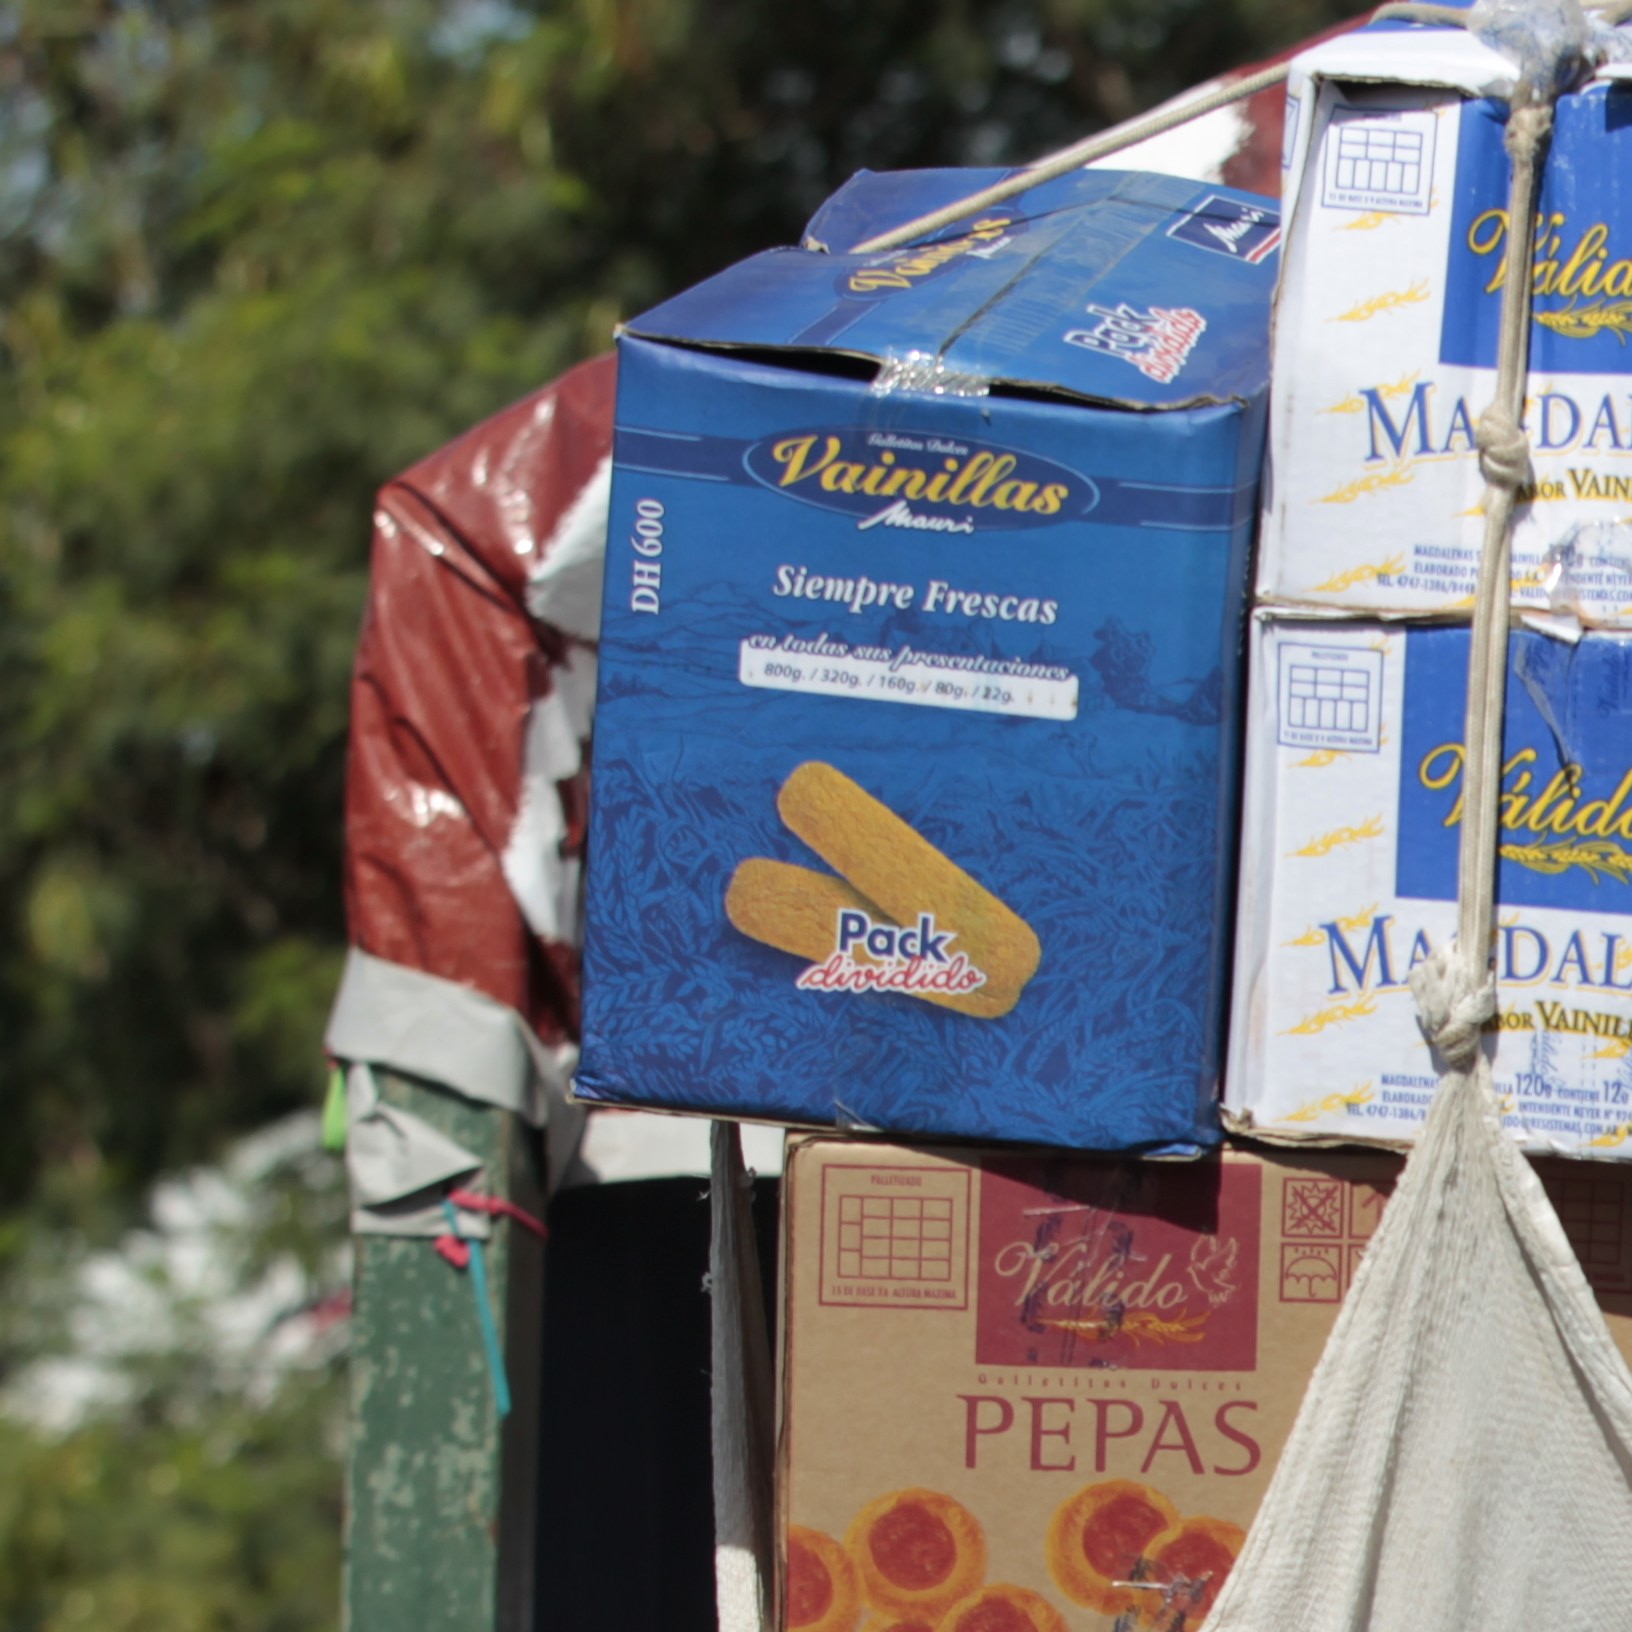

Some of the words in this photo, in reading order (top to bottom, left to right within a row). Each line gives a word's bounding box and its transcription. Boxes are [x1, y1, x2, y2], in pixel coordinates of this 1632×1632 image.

[771, 434, 1069, 515] Vainillas
[1516, 479, 1566, 501] ABOR
[630, 499, 665, 557] 600
[631, 560, 661, 616] DH
[772, 564, 915, 614] Siempre
[922, 579, 1059, 625] Frescas
[748, 635, 777, 652] en
[781, 632, 848, 658] todas
[853, 644, 893, 662] sus
[888, 645, 1070, 682] presentaciones
[822, 667, 863, 688] 320g.
[837, 909, 955, 963] Pack
[800, 953, 986, 994] dividido
[1514, 1072, 1552, 1099] 120g
[994, 1240, 1188, 1309] Válido
[977, 1372, 1127, 1389] Galletitas
[1150, 1377, 1243, 1392] Dulces
[955, 1393, 1262, 1477] PEPAS
